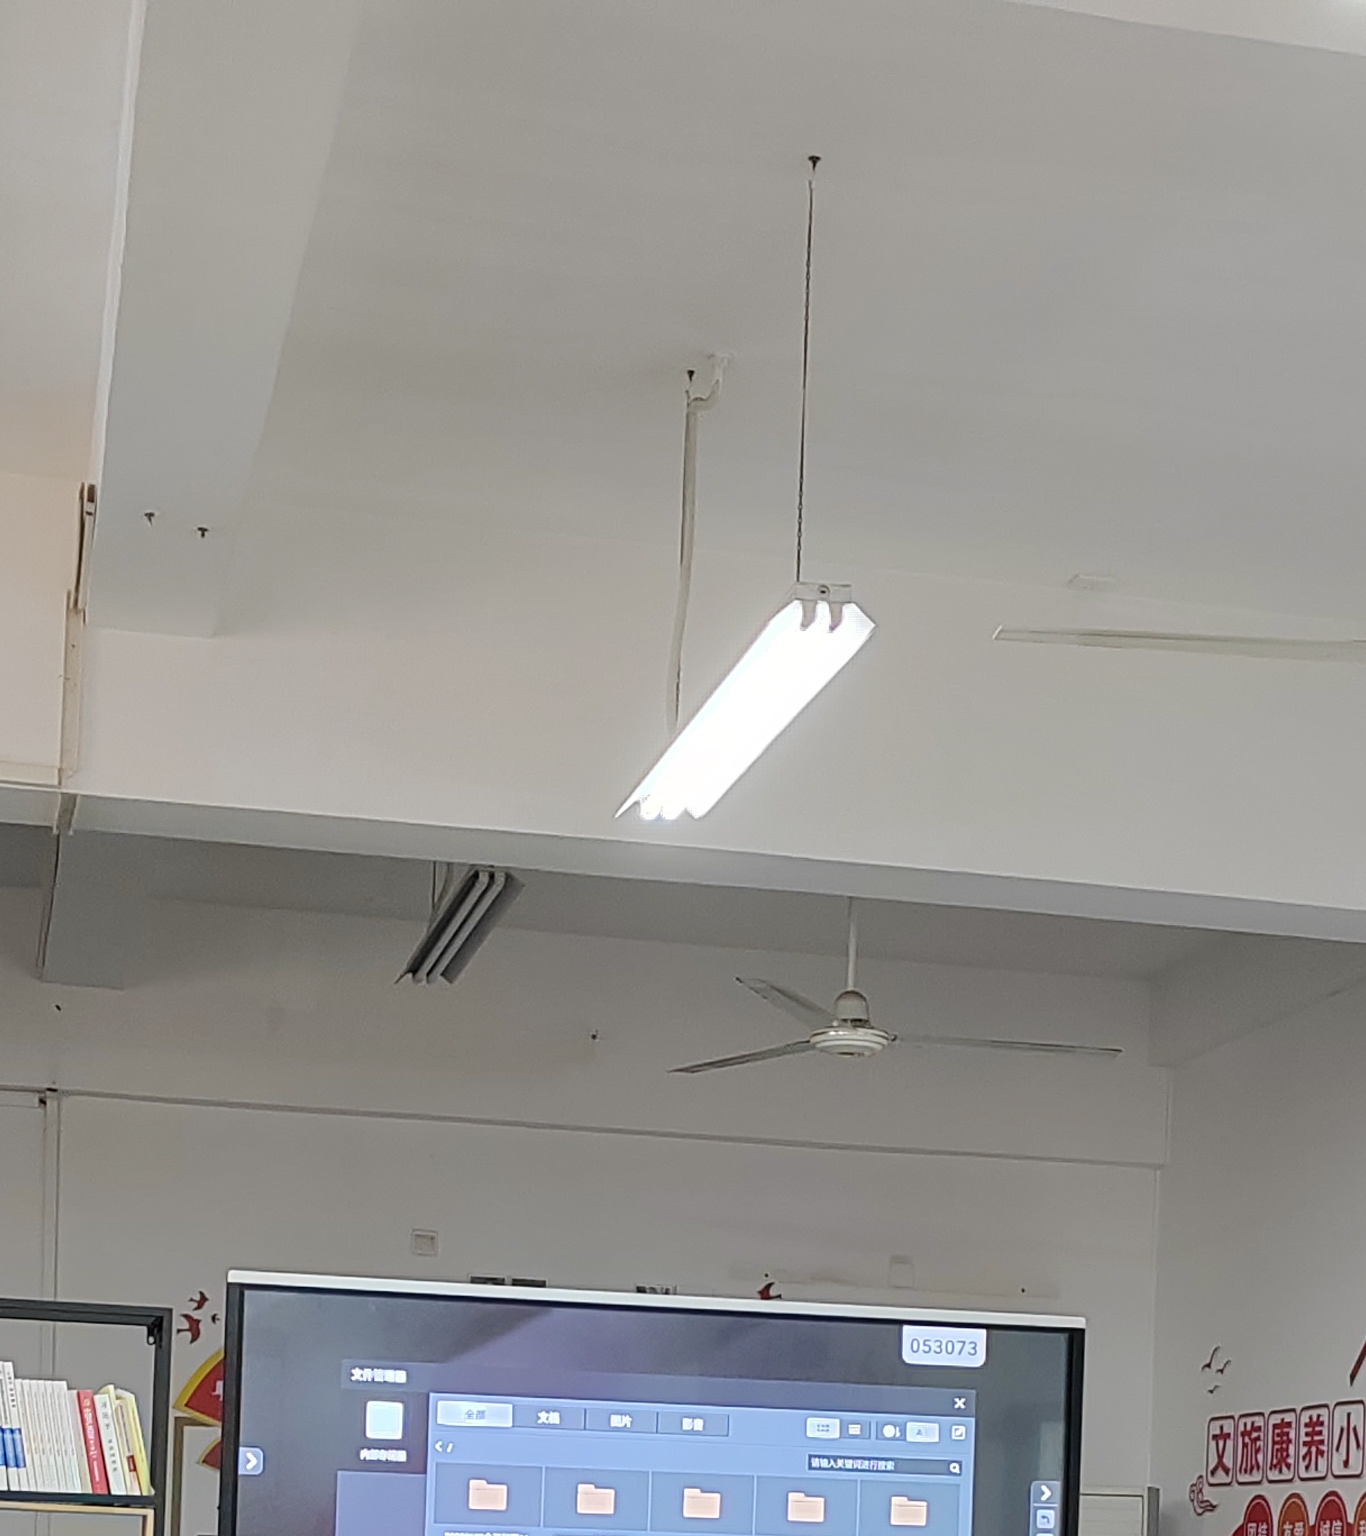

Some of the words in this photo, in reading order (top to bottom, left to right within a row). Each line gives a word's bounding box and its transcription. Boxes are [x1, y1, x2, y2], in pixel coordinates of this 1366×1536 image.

[909, 1337, 979, 1357] 053073
[537, 1411, 560, 1425] 文档
[609, 1414, 633, 1428] 图片
